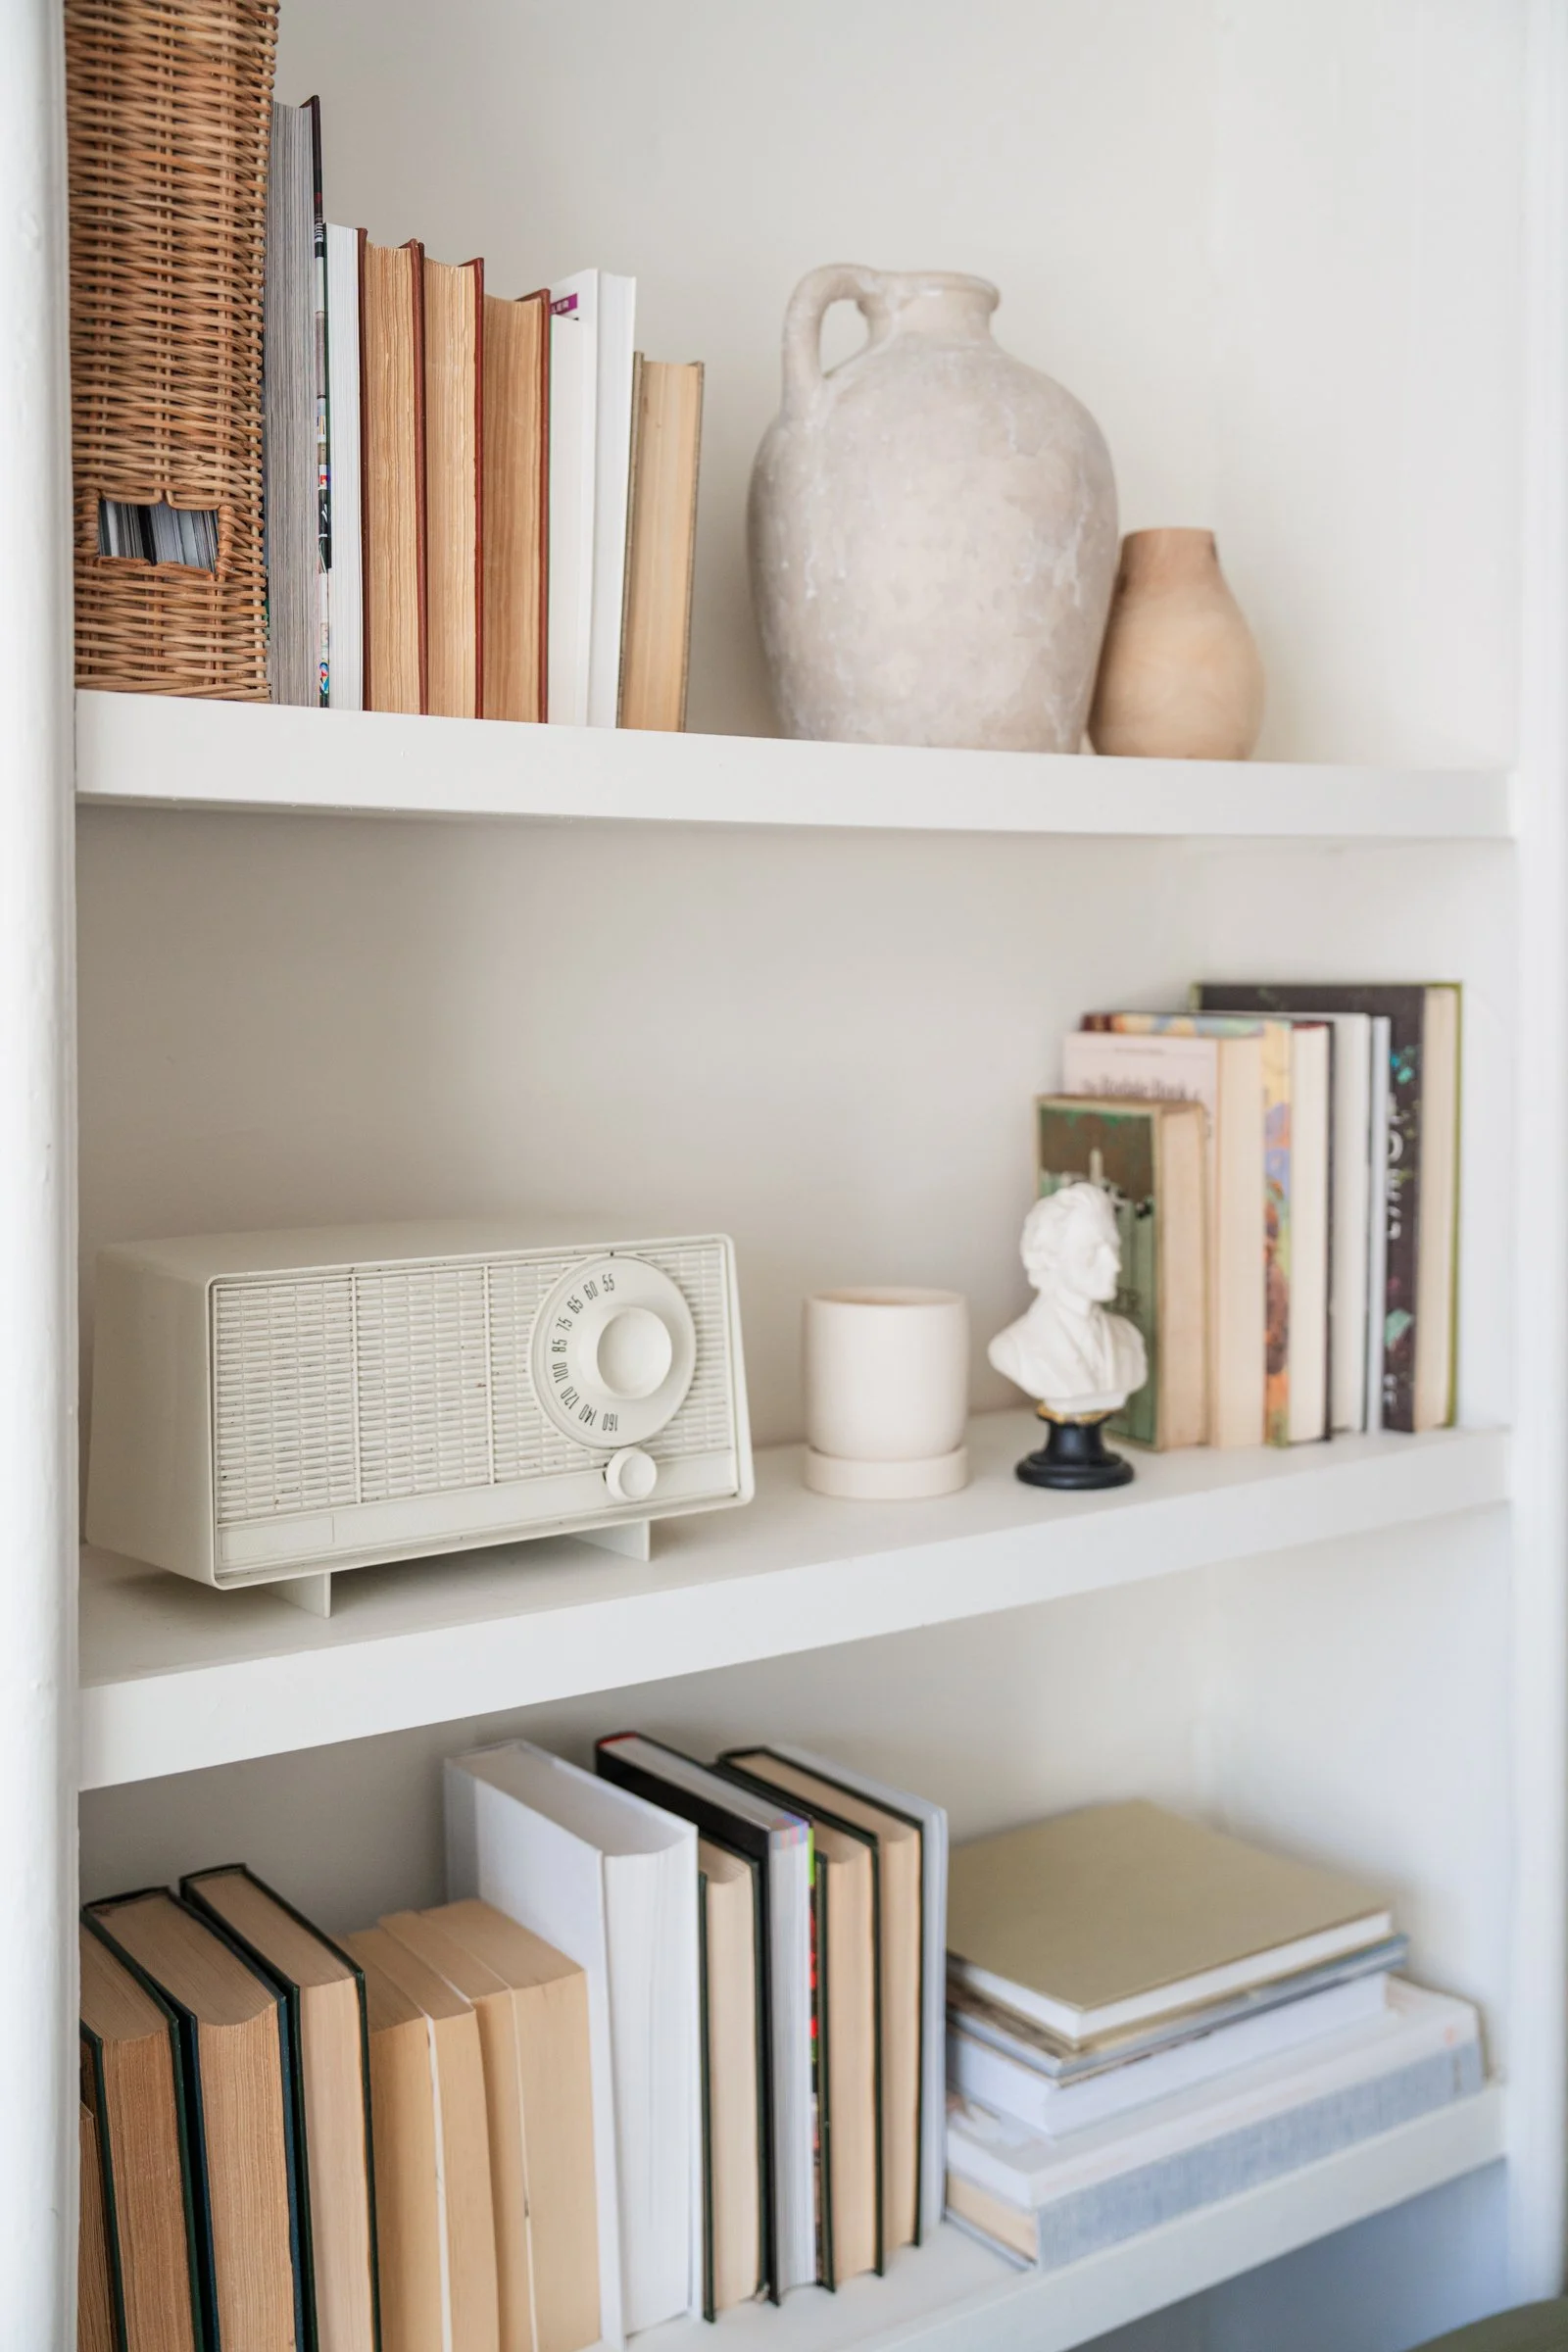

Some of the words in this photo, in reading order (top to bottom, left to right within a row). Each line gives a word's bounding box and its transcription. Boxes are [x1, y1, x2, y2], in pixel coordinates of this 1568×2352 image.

[583, 1280, 599, 1300] 60
[602, 1273, 615, 1292] 55
[566, 1294, 584, 1314] 65
[555, 1316, 573, 1332] 75
[551, 1339, 567, 1353] 85
[552, 1361, 569, 1384] 100
[560, 1386, 580, 1410] 120
[578, 1403, 598, 1427] 140
[602, 1412, 619, 1432] 160
